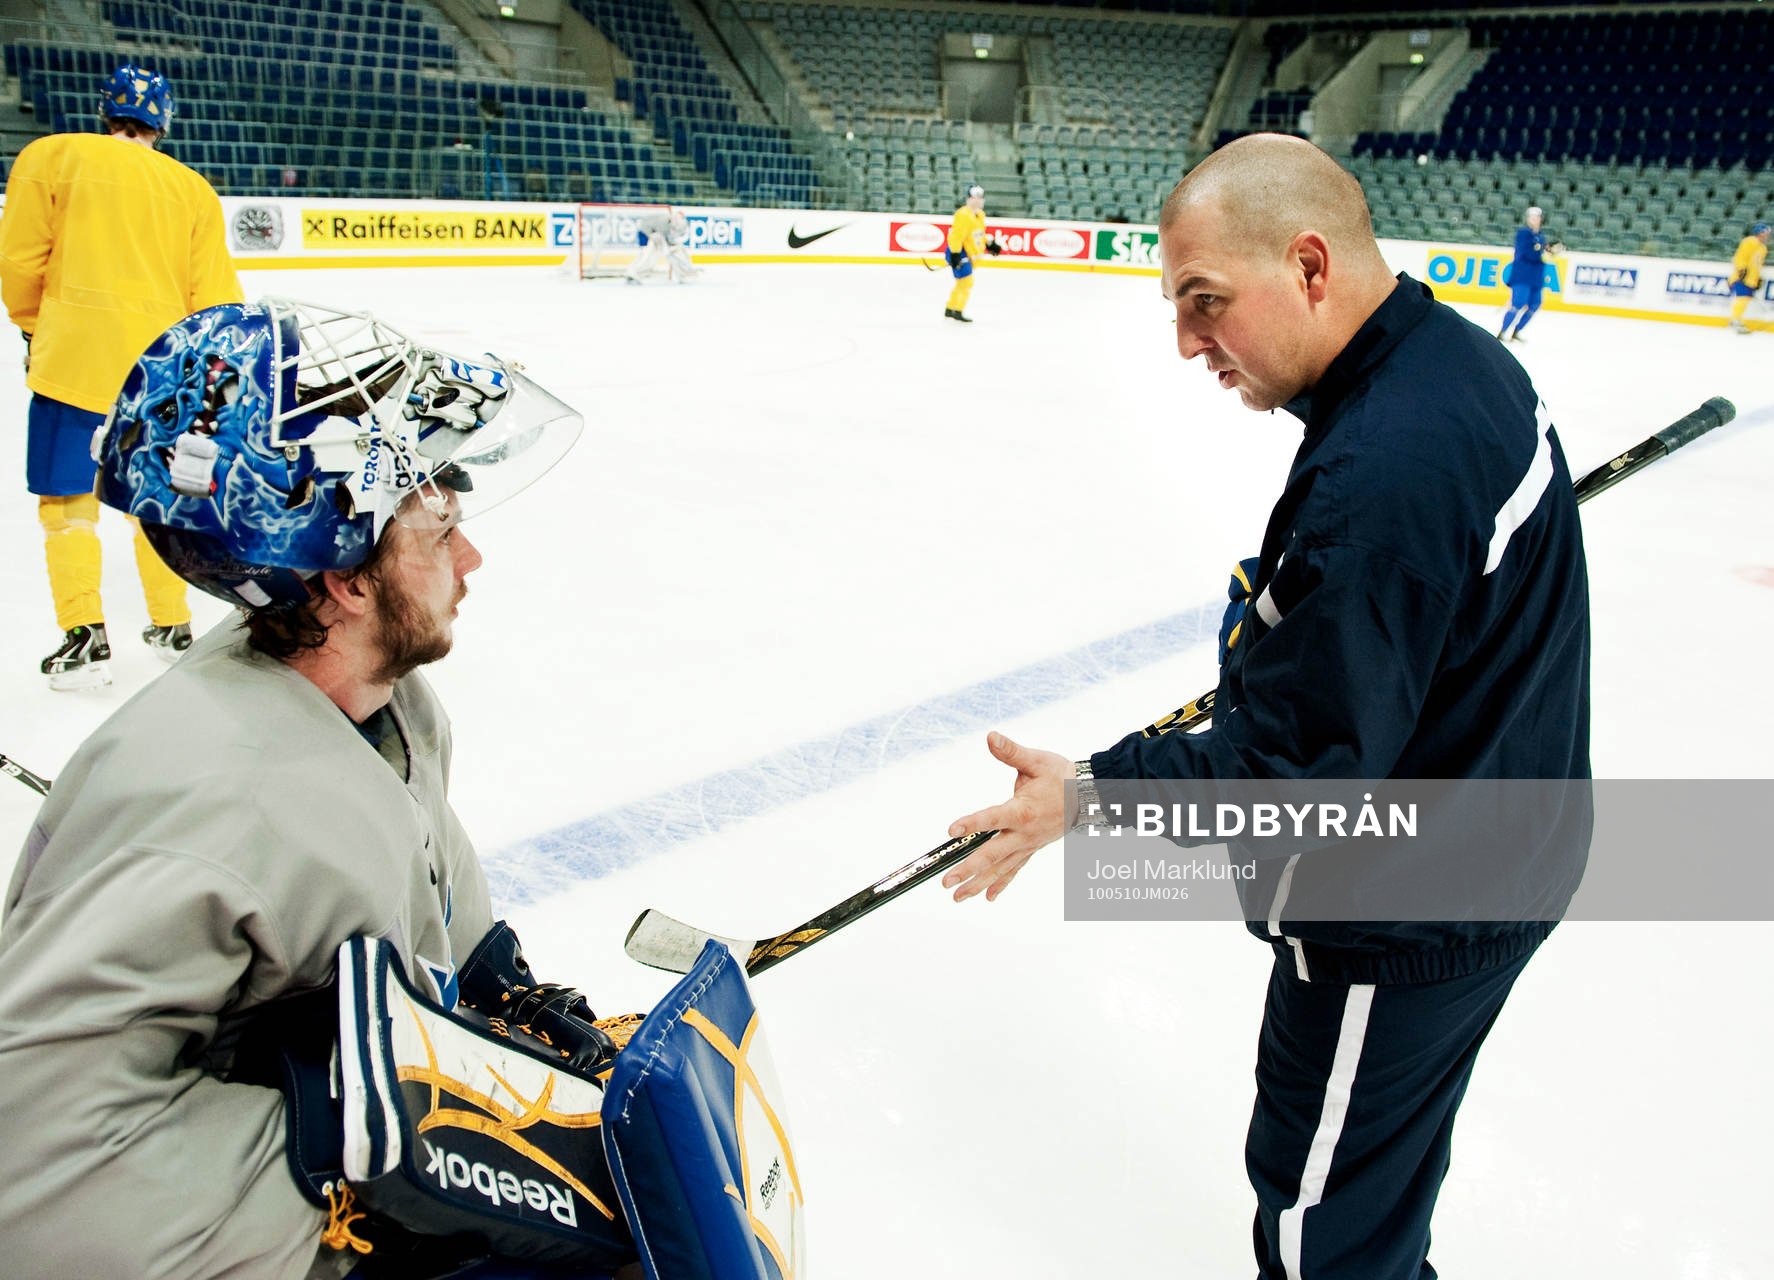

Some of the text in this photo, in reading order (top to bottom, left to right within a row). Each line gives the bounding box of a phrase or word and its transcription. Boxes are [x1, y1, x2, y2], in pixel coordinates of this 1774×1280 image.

[333, 216, 544, 239] Raiffeisen BANK
[1428, 255, 1561, 292] OJEA
[1577, 267, 1634, 287] NIVEA
[1669, 274, 1730, 294] NIVEA
[422, 1138, 578, 1228] Reebok
